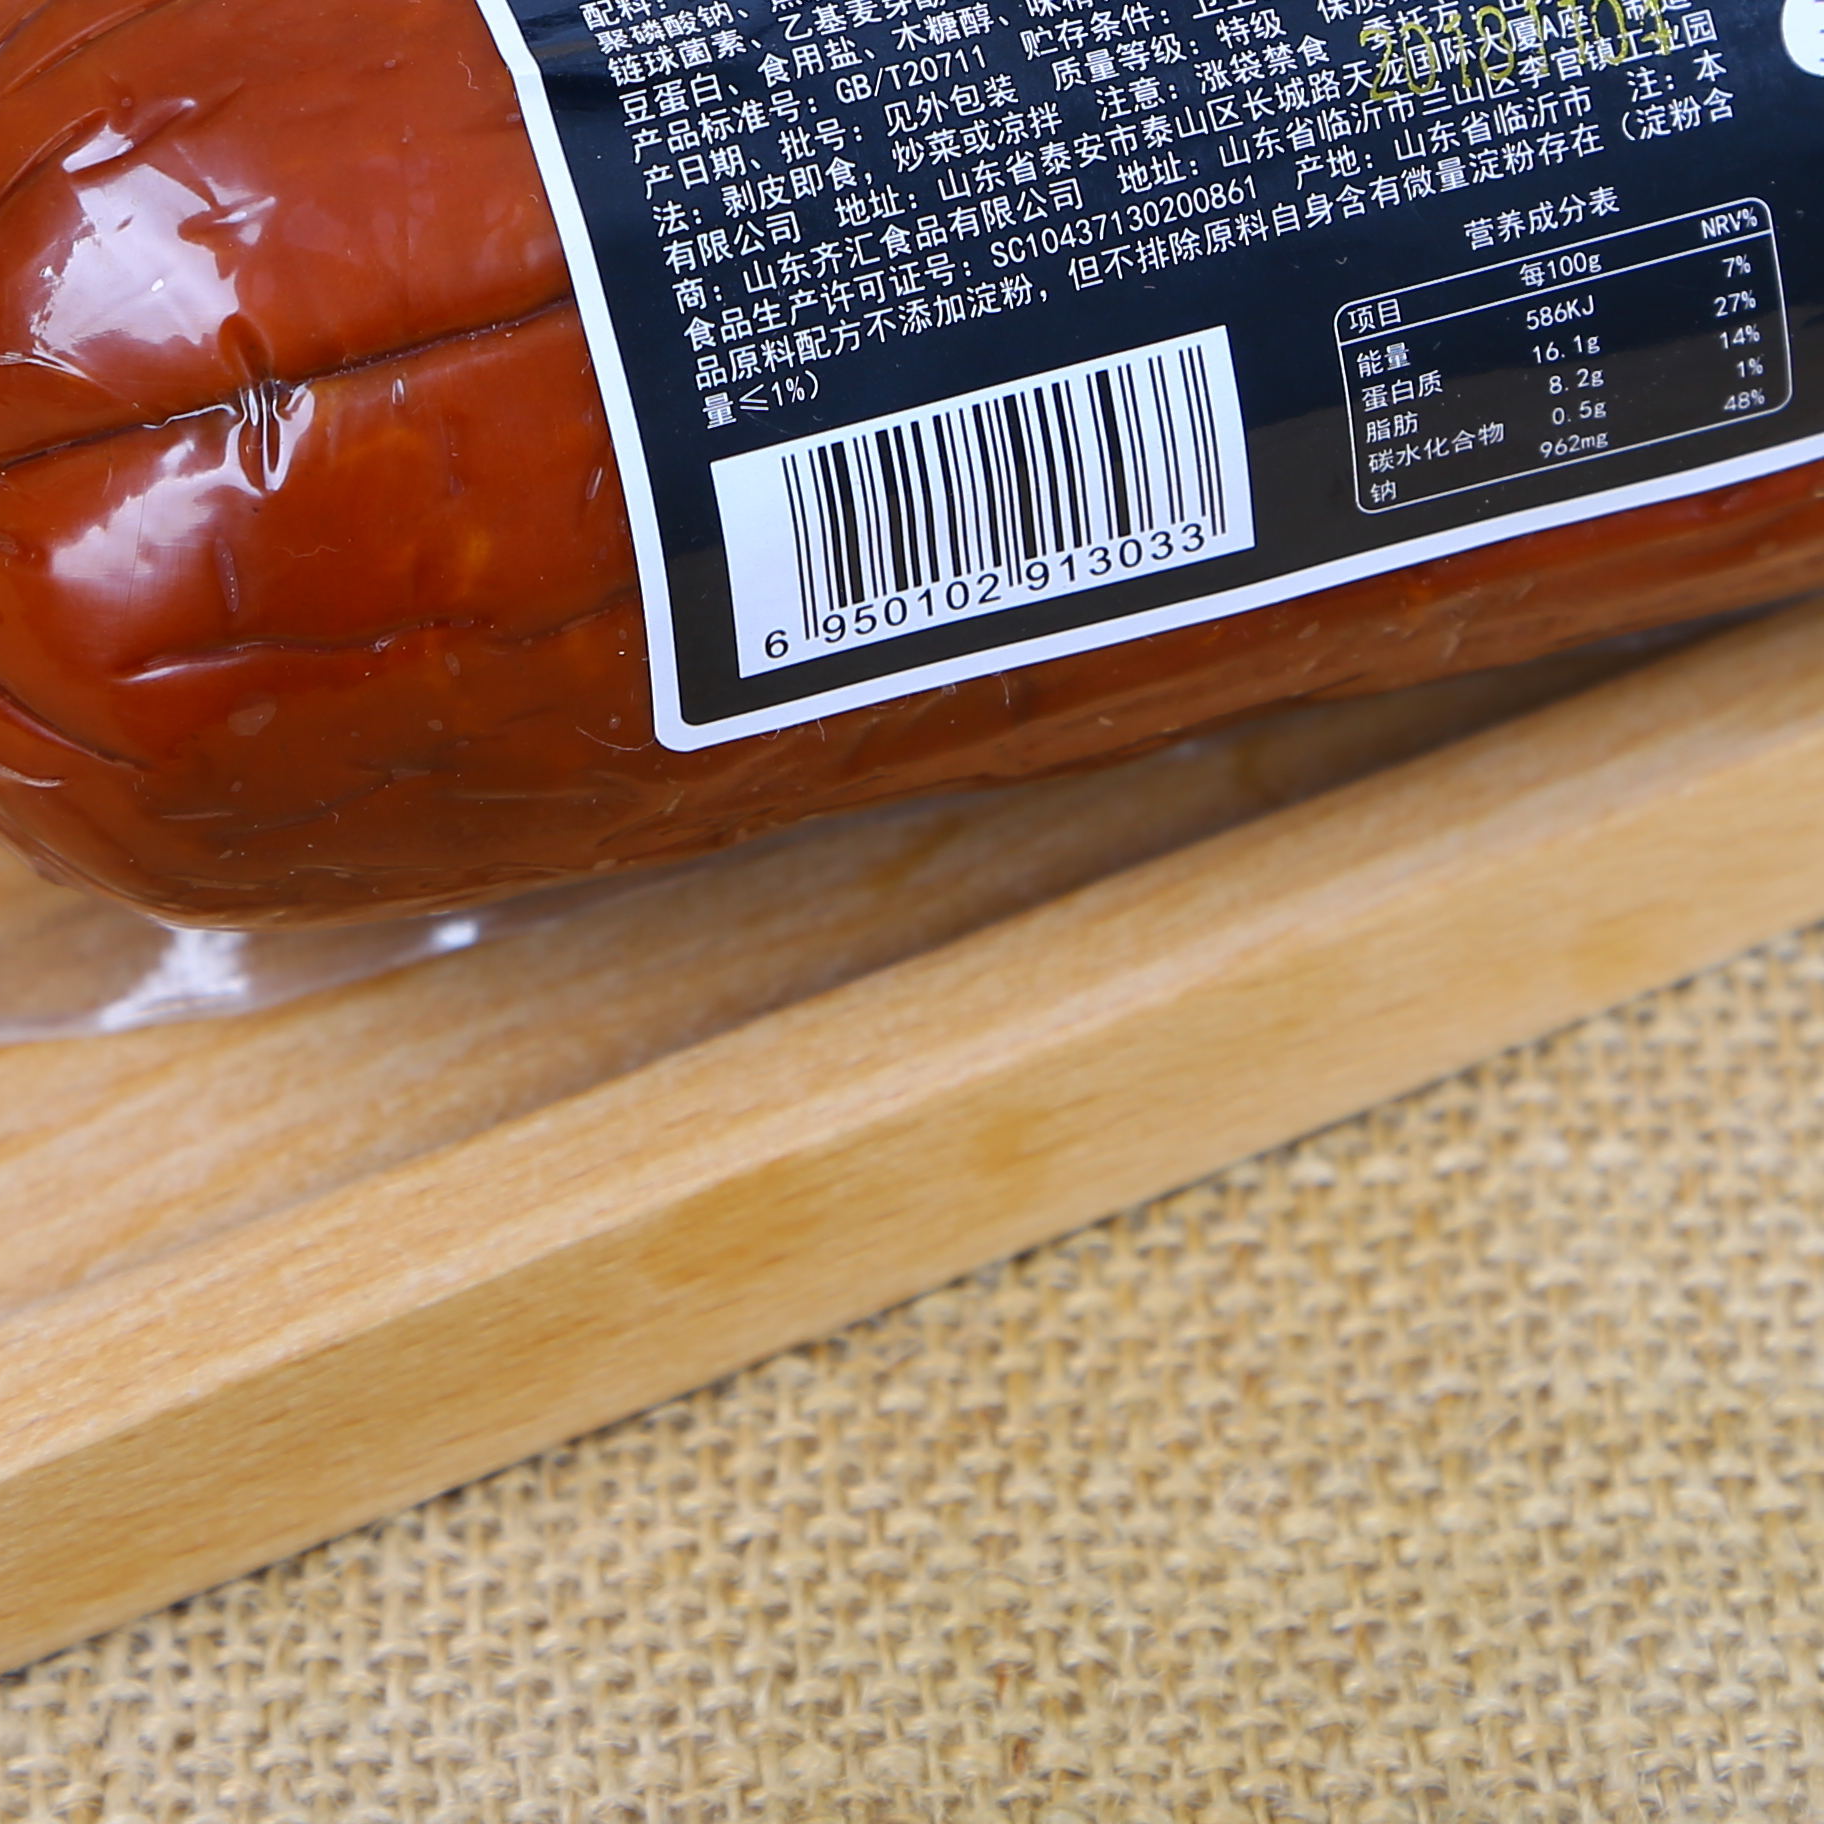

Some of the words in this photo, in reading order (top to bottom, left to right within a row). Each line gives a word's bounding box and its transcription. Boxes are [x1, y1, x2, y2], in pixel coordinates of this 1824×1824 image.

[662, 210, 801, 275] 有限公司
[1347, 298, 1401, 334] 项目
[1519, 251, 1602, 287] 每100g
[1700, 207, 1758, 239] NRV%
[1463, 186, 1620, 250] 营养成分表
[1356, 342, 1410, 378] 能量
[1526, 294, 1594, 330] 586KJ
[1722, 255, 1751, 277] 7%
[1361, 369, 1443, 412] 蛋白质
[1532, 335, 1600, 363] 16.1g
[1714, 290, 1756, 317] 27%
[1366, 410, 1418, 443] 脂肪
[1549, 368, 1604, 394] 8.2g
[1719, 324, 1760, 349] 14%
[1368, 422, 1504, 473] 碳水化合物
[1552, 400, 1606, 425] 0.5g
[1736, 358, 1763, 377] 1%
[1370, 479, 1396, 503] 钠
[1539, 432, 1608, 458] 962mg
[1723, 389, 1765, 410] 48%
